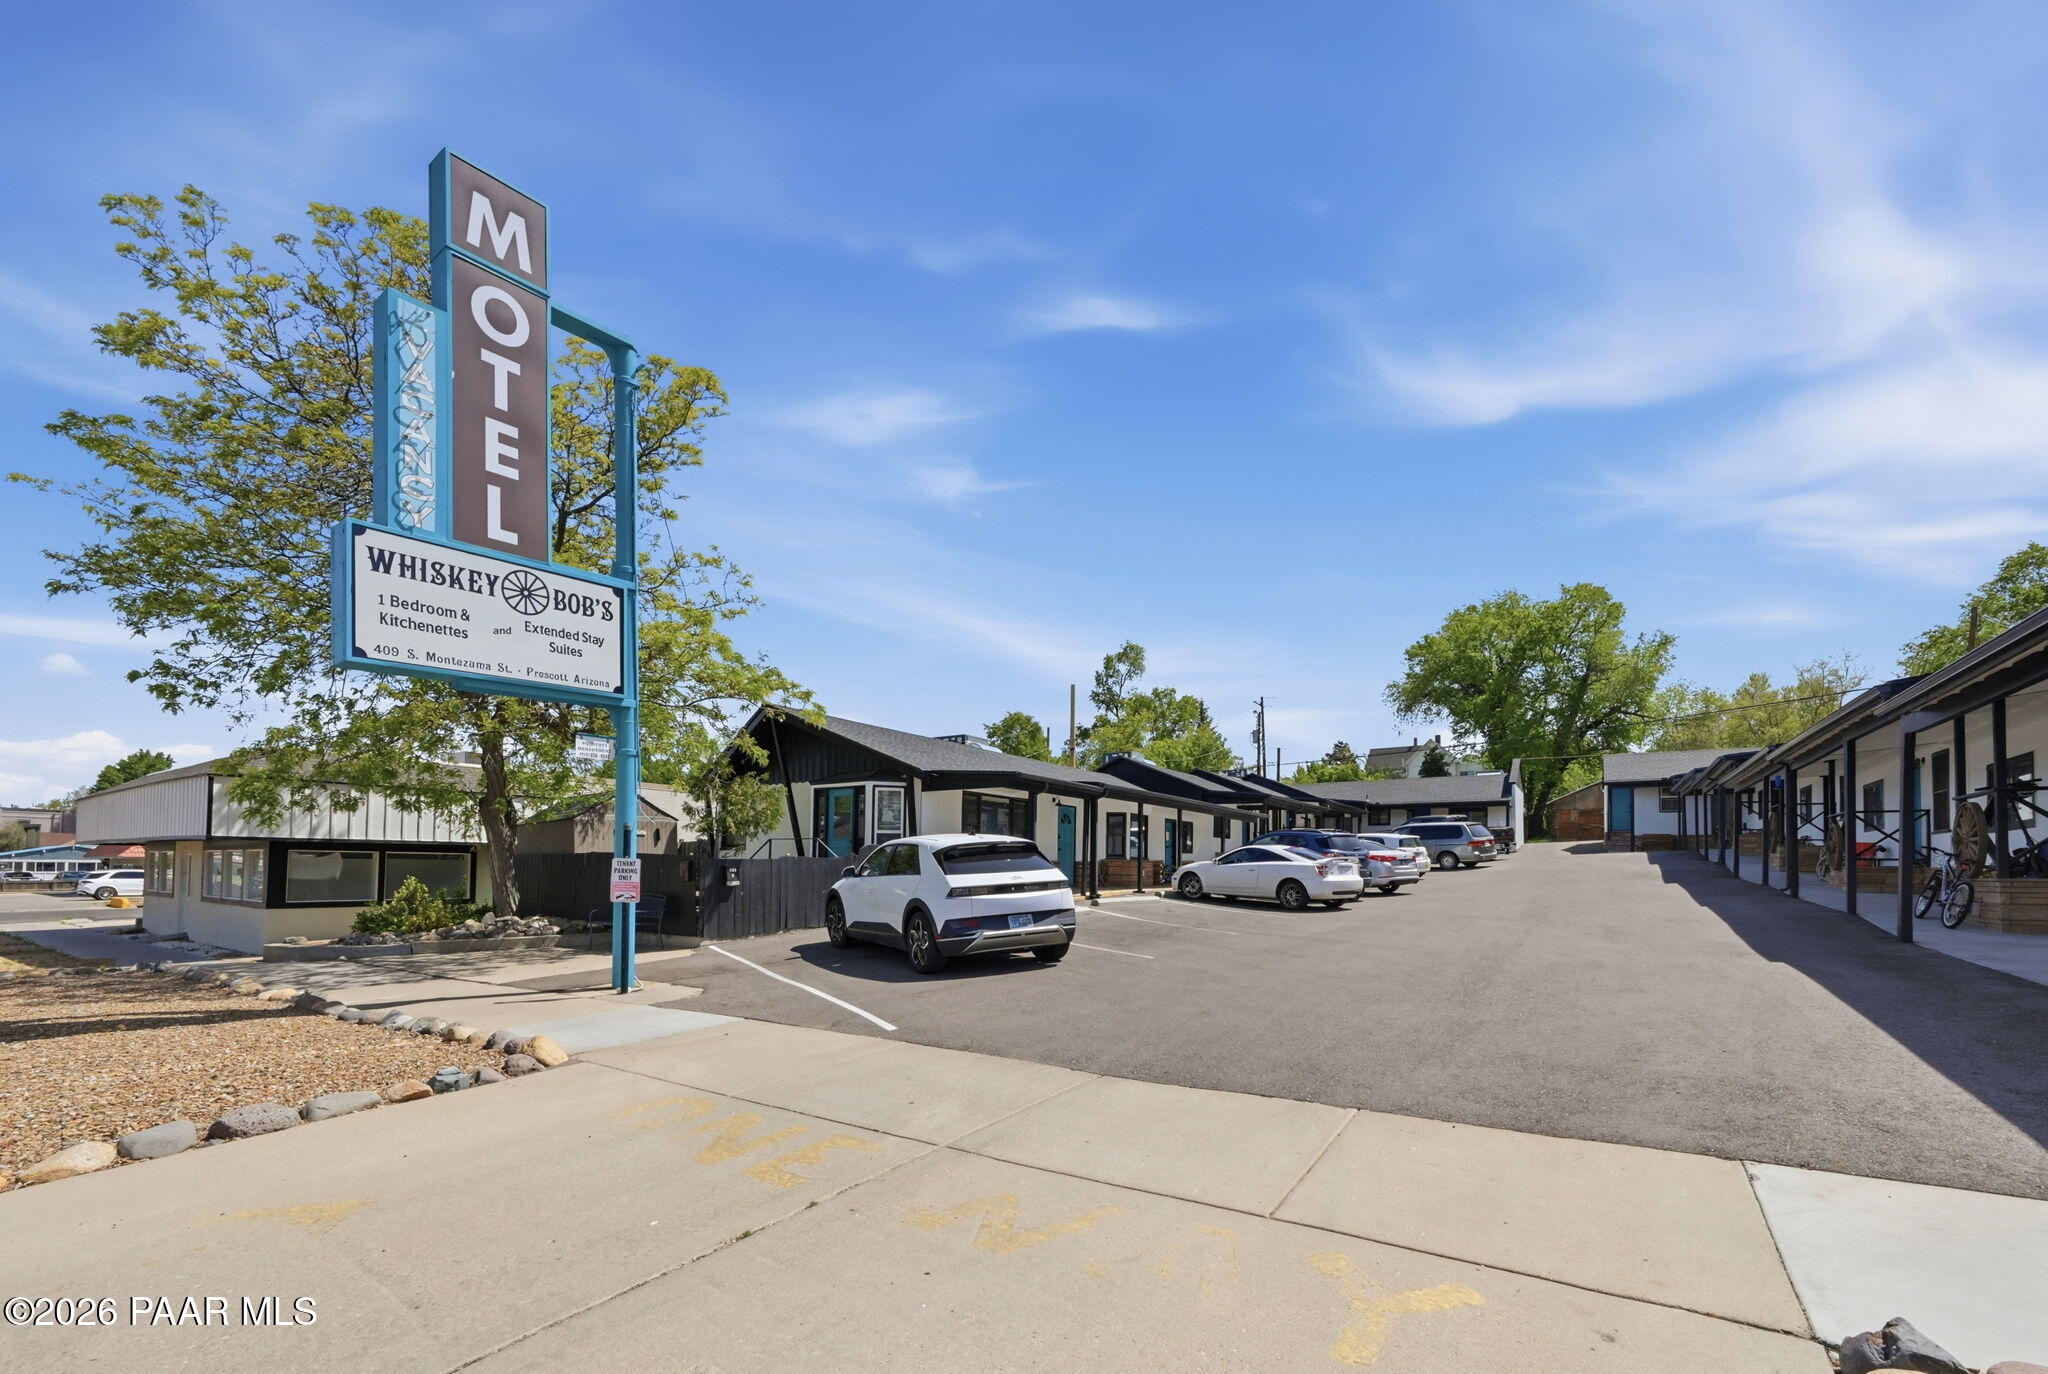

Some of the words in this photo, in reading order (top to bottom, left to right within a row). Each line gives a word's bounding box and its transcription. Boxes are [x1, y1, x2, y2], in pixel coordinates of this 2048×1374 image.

[465, 190, 533, 547] MOTEL
[400, 331, 436, 528] VACANCY
[365, 544, 500, 597] WHISKEY
[552, 589, 614, 622] BOB'S
[378, 594, 385, 605] 1
[390, 595, 458, 619] Bedroom
[460, 611, 471, 622] &
[379, 611, 469, 640] Kitchenettes
[493, 626, 512, 636] and
[524, 621, 580, 642] Extended
[582, 632, 605, 648] Stay
[549, 642, 583, 658] Suites
[373, 644, 399, 657] 409
[407, 649, 419, 660] S.
[426, 651, 492, 672] Montezuma
[497, 663, 512, 674] St.
[574, 674, 610, 688] Arizona
[613, 867, 638, 875] PARKING
[600, 1097, 886, 1190] ONE
